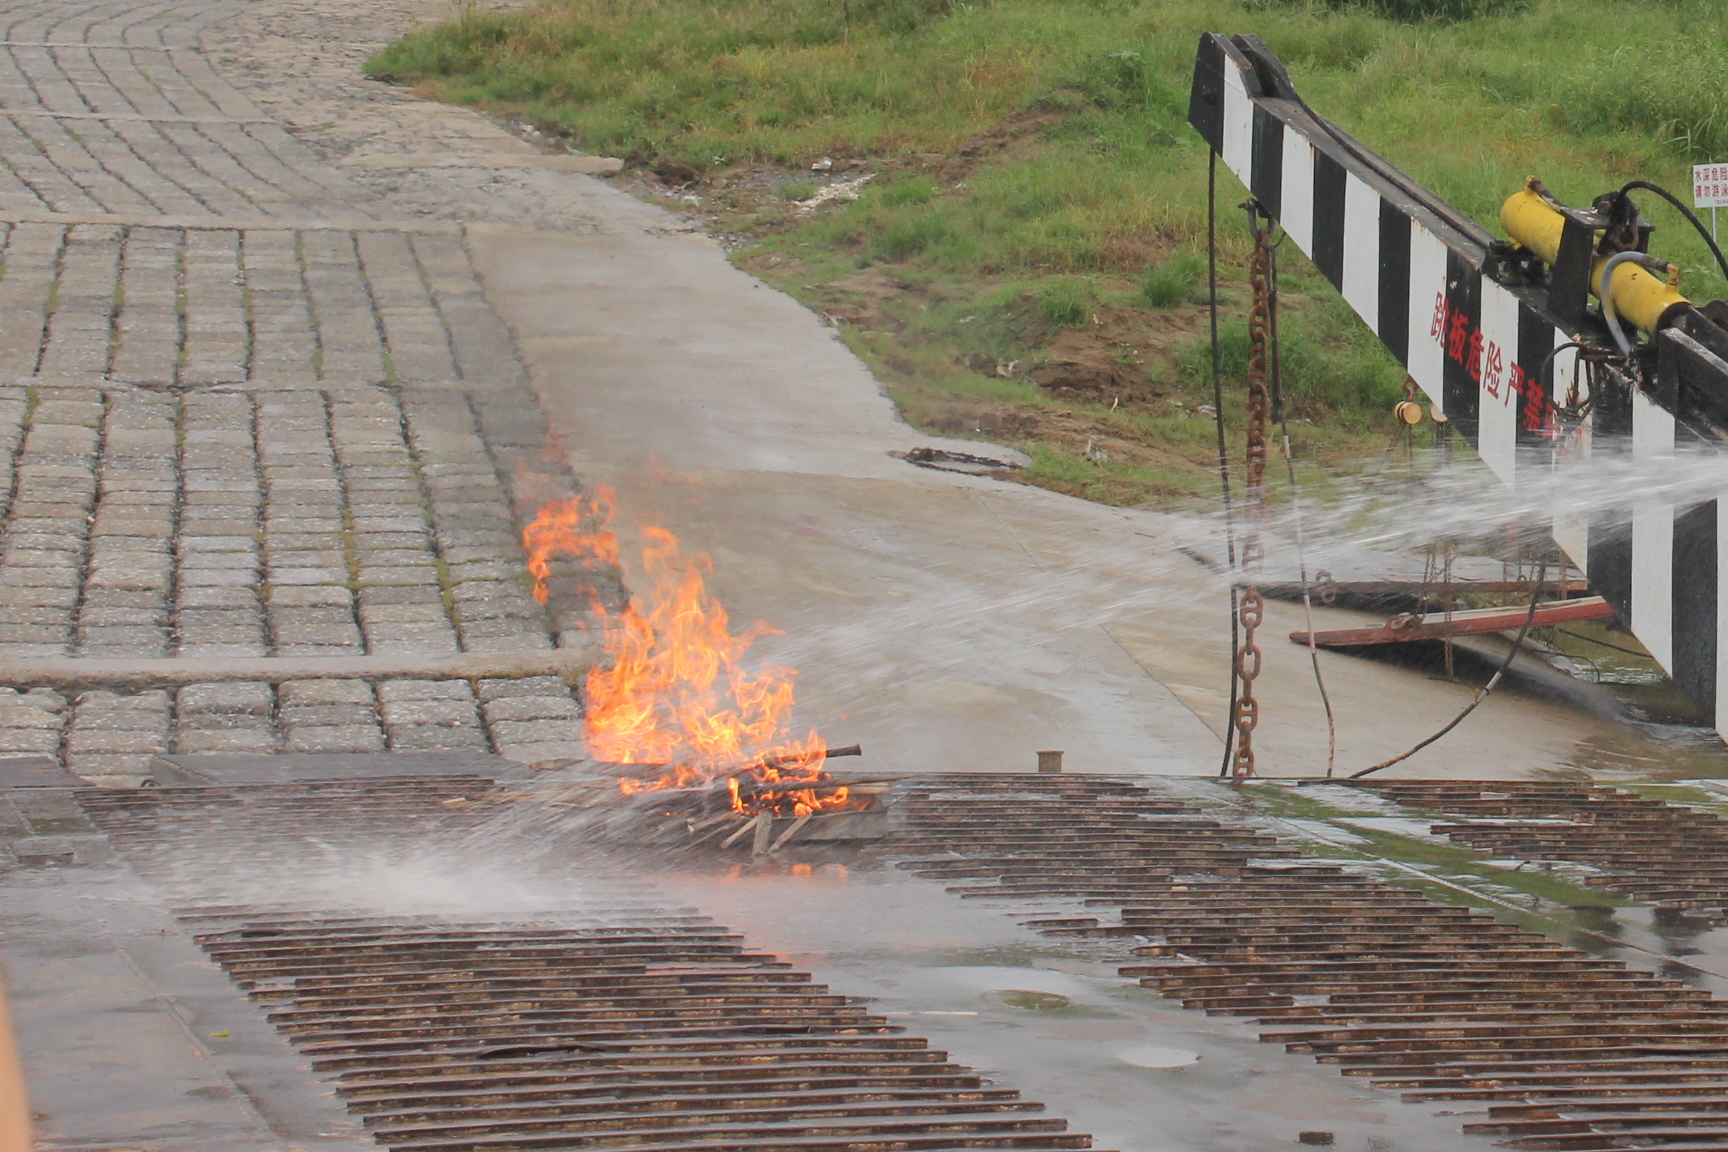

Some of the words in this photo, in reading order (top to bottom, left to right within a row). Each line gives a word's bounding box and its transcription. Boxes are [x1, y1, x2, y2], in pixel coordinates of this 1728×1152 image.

[1694, 167, 1728, 182] 水深危险
[1694, 183, 1728, 198] 请勿游泳
